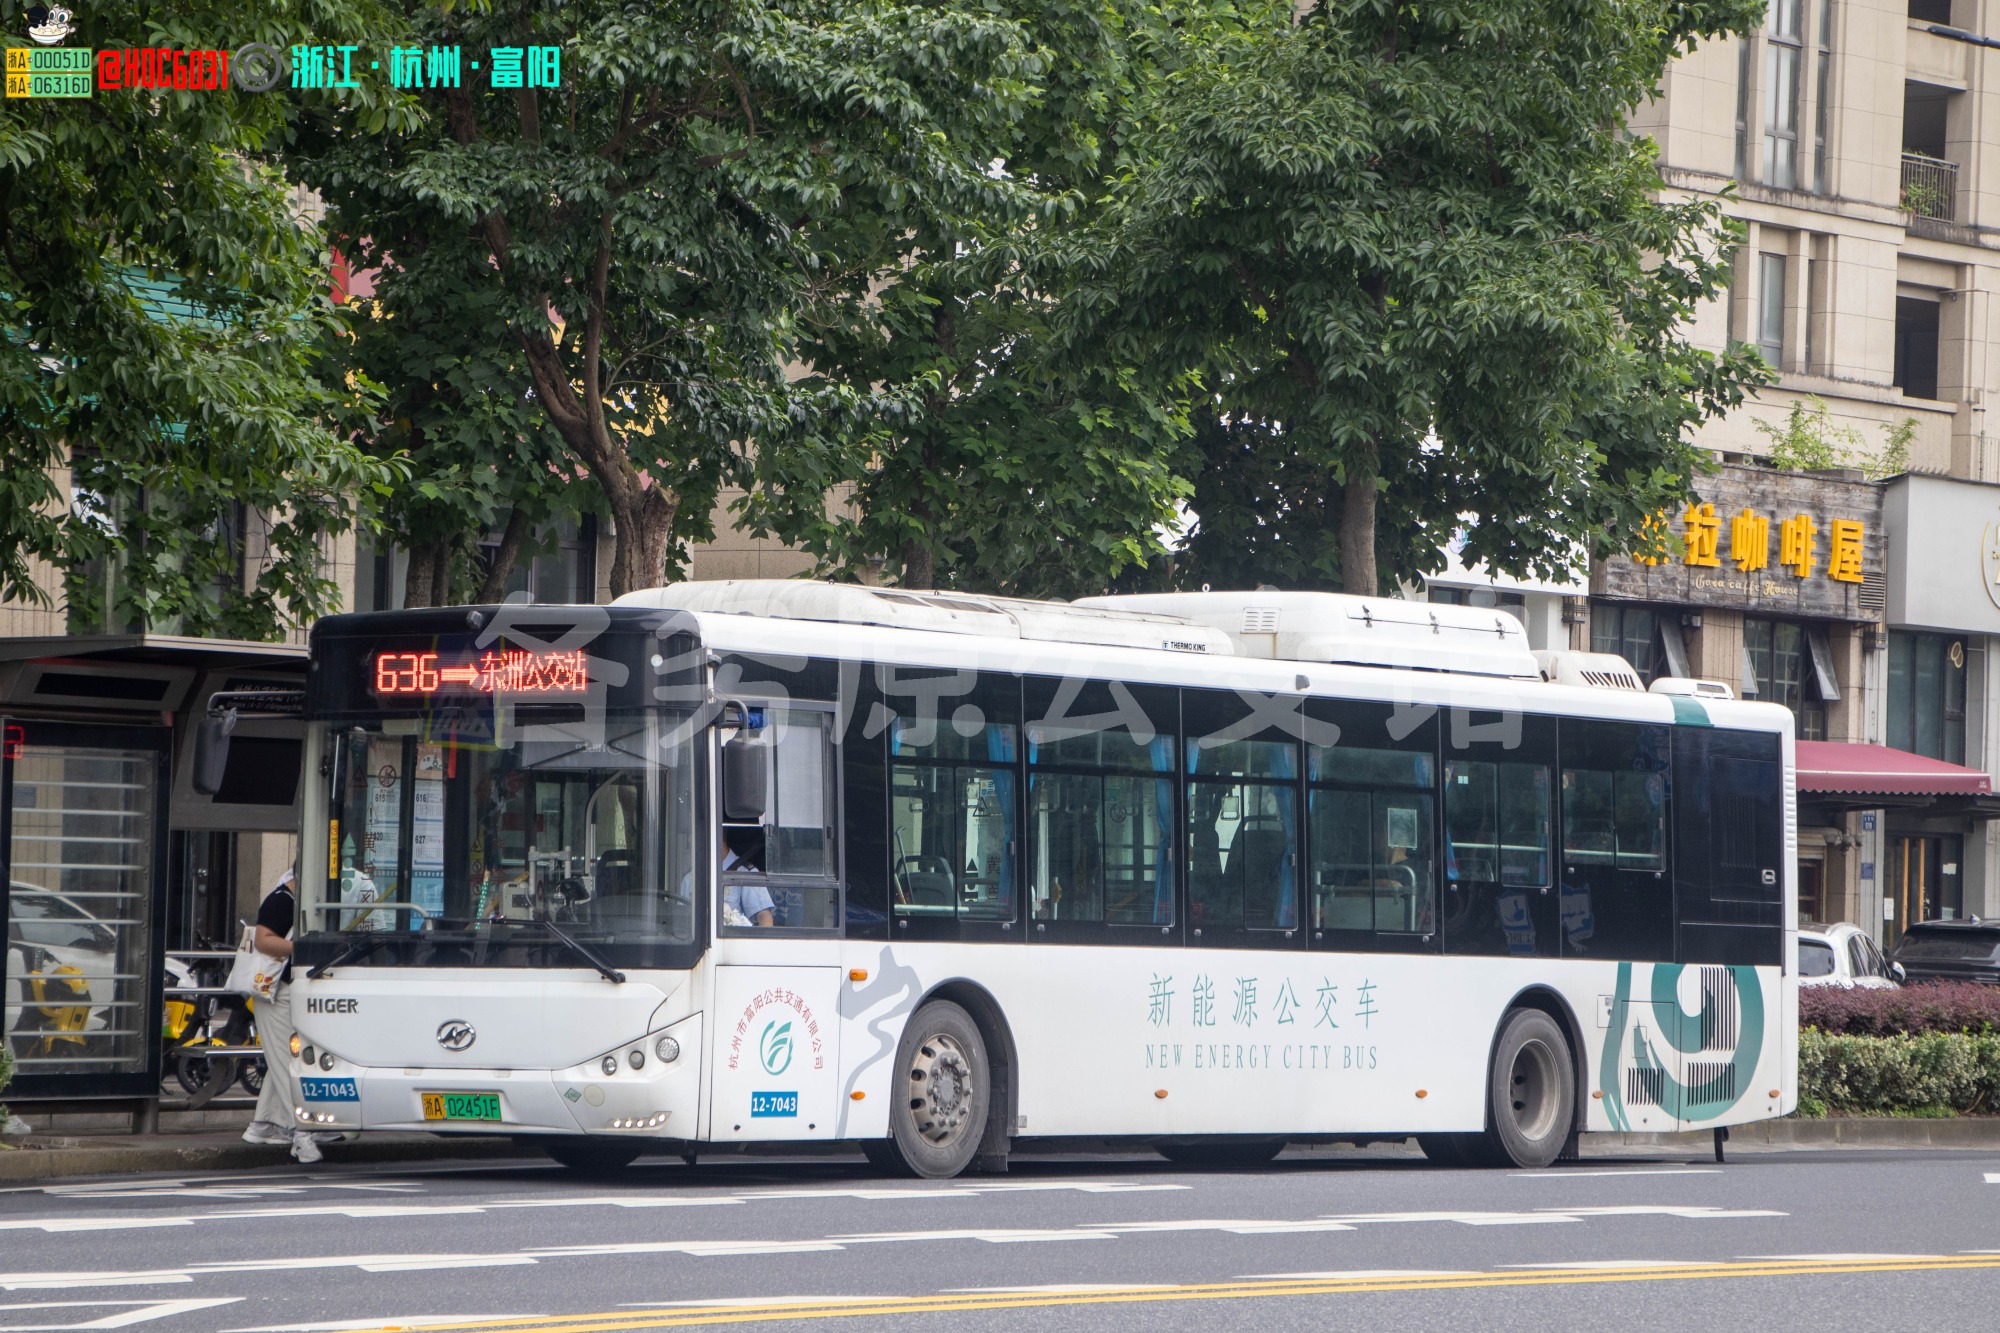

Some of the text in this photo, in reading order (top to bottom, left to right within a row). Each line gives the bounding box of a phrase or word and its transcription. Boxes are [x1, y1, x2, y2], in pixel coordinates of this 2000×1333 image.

[1170, 641, 1192, 651] THERMO
[1193, 643, 1206, 652] KING
[378, 650, 587, 692] 636 东洲公交站
[415, 793, 427, 803] 616
[306, 998, 359, 1014] HIGER
[1147, 972, 1379, 1030] 新能源公交车
[728, 987, 824, 1071] 杭州市富阳公共交通有限公司
[1145, 1044, 1378, 1070] NEW ENERGY CITY BUS
[303, 1081, 357, 1098] 12-7043
[752, 1096, 797, 1113] 12-7043
